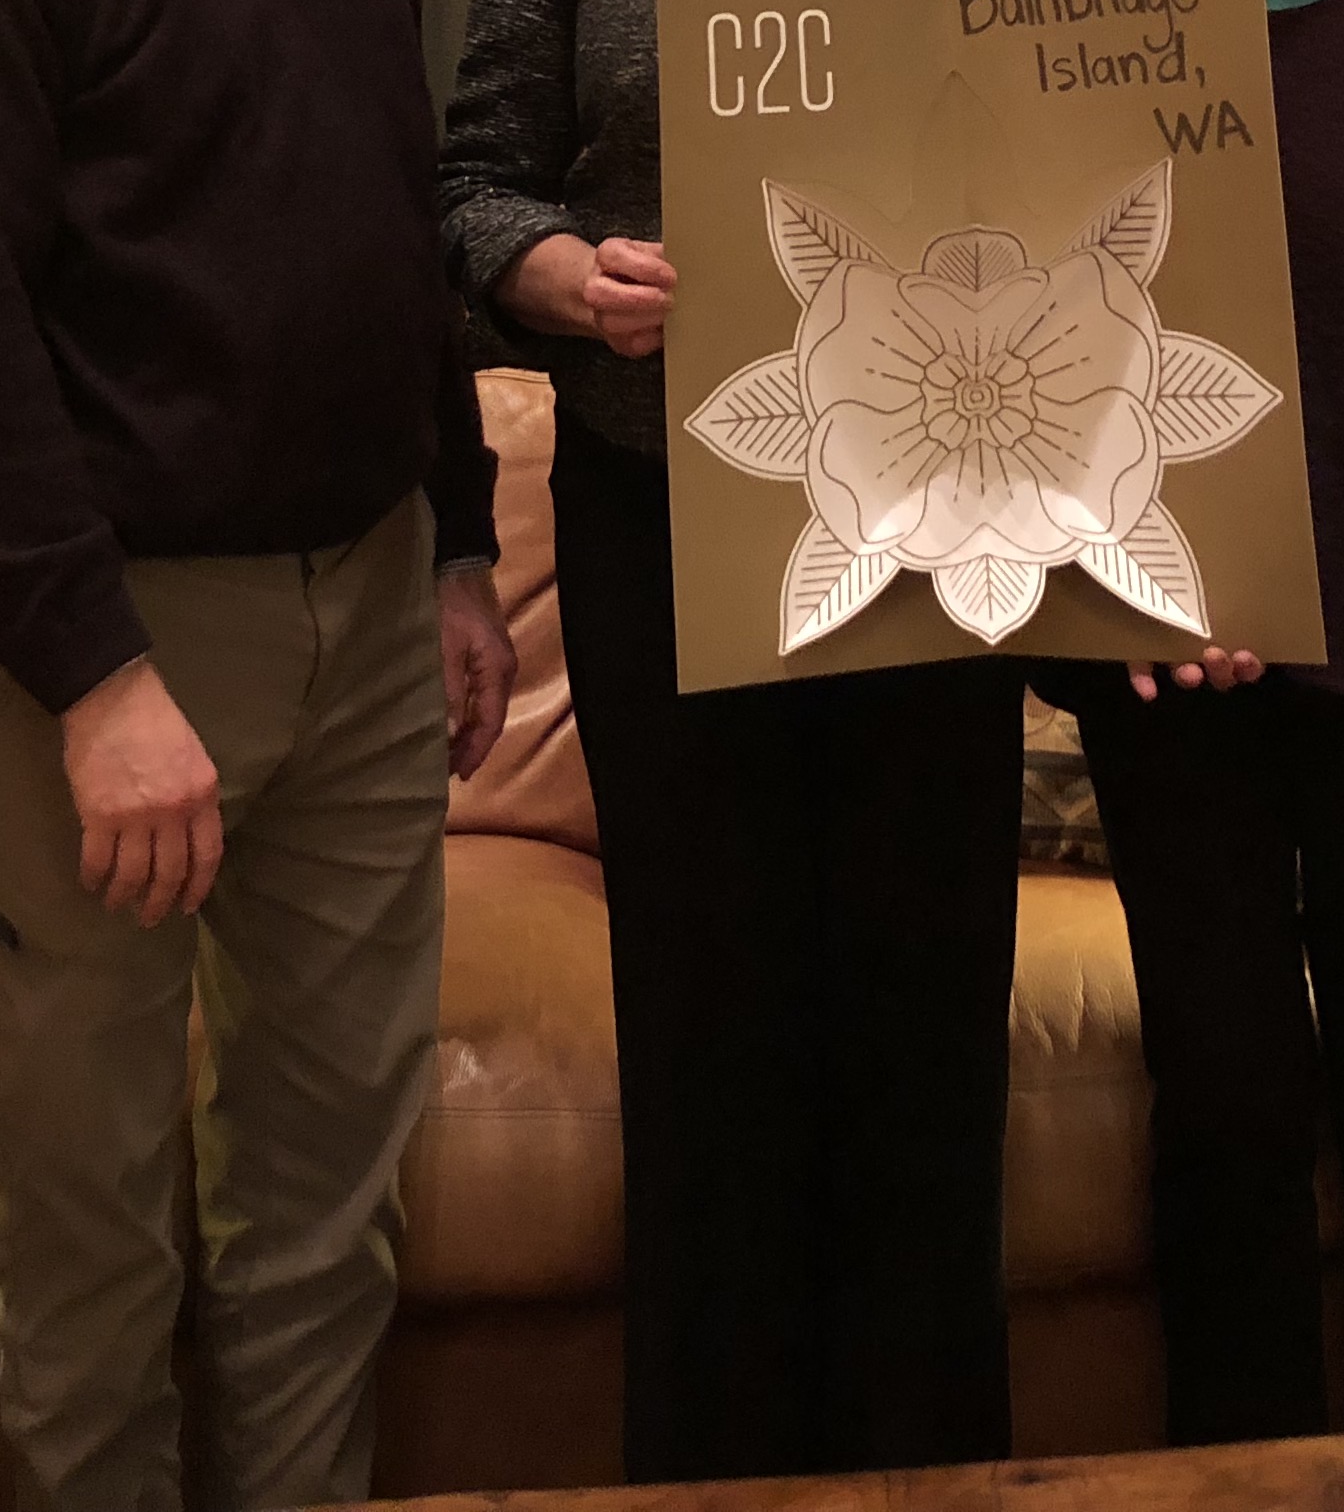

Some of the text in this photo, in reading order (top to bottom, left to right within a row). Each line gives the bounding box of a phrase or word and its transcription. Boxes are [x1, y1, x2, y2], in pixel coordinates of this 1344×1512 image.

[708, 9, 835, 117] C2C
[1036, 31, 1207, 94] Island,
[1154, 100, 1255, 155] WA
